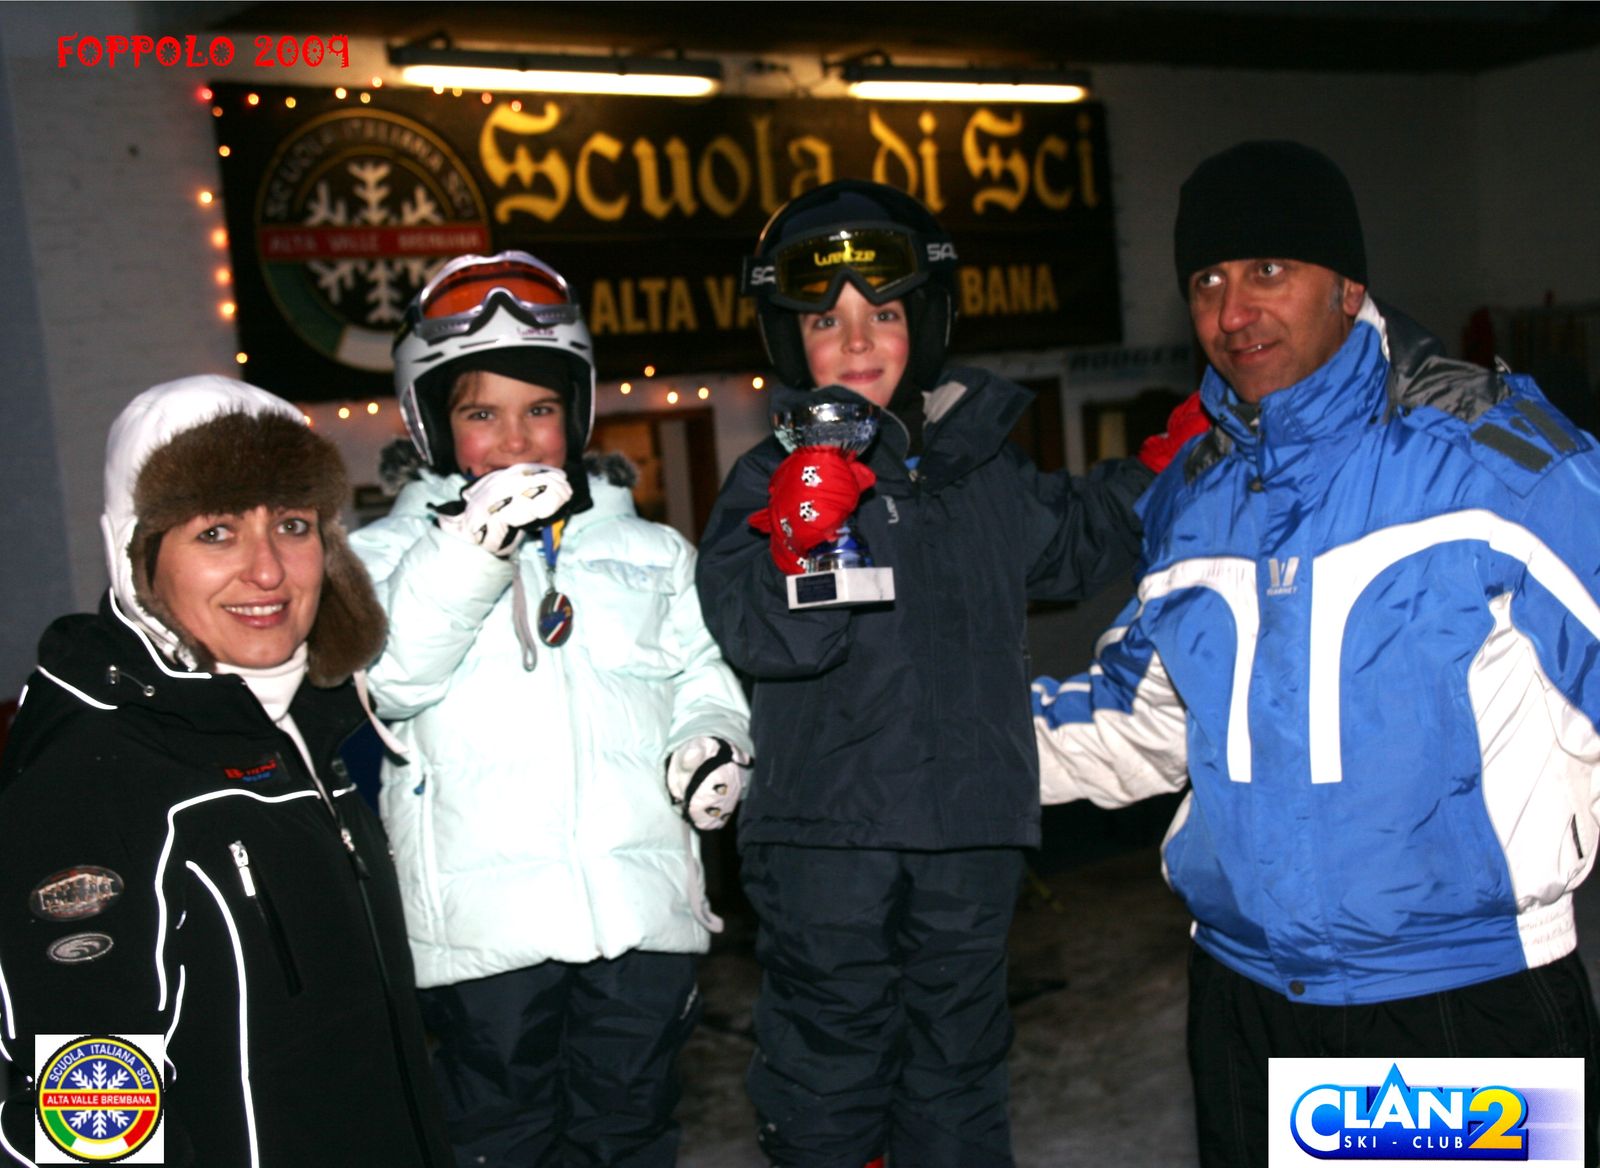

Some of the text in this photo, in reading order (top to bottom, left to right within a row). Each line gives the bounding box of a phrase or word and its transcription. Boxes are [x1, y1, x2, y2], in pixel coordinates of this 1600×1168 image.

[479, 101, 1098, 224] Scuola di Sci
[590, 275, 699, 336] ALTA
[958, 263, 1060, 317] BANA
